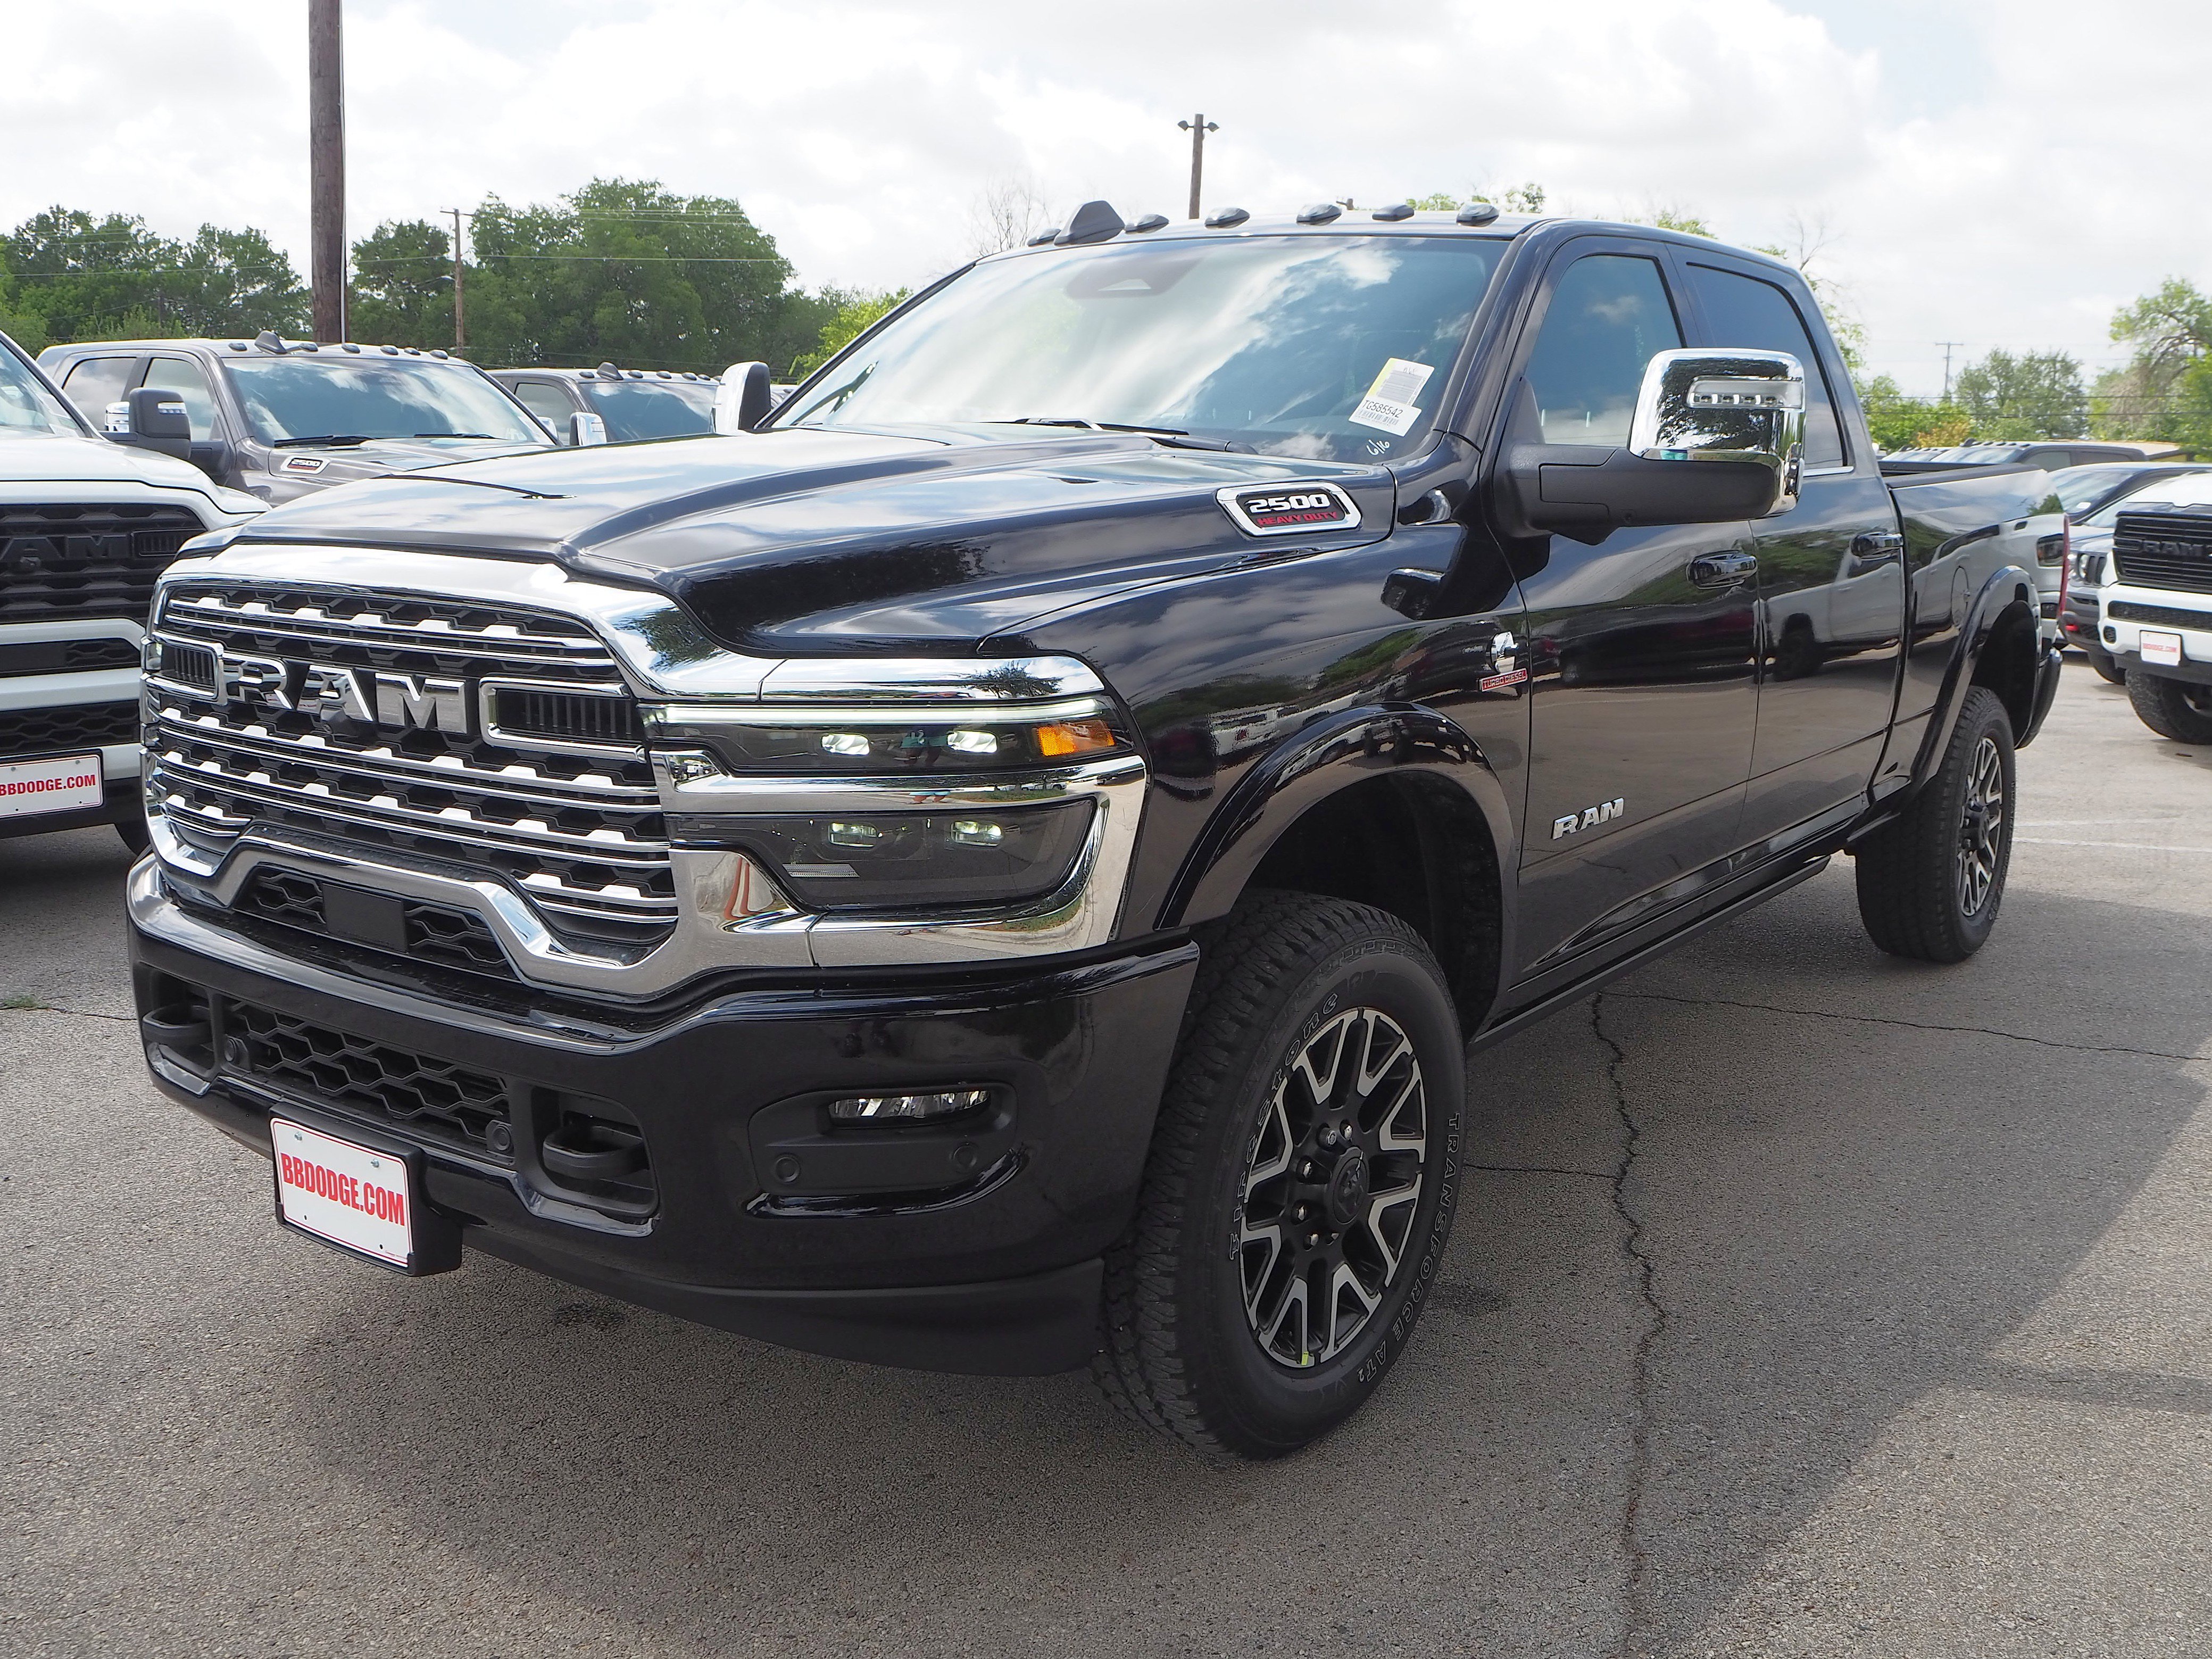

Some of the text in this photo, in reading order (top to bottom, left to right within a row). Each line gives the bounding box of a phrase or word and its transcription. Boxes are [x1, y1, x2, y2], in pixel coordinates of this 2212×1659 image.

[1362, 400, 1403, 418] TG585542
[1246, 494, 1330, 513] 2500
[1257, 511, 1338, 526] HEAVY DUTY
[1483, 670, 1527, 689] TURBO DIESEL
[222, 650, 467, 734] RAM
[0, 775, 96, 795] BBDODGE.COM
[1552, 798, 1624, 840] RAM
[280, 1152, 405, 1226] BBDODGE.COM
[1392, 1113, 1460, 1341] TRANSFORCE
